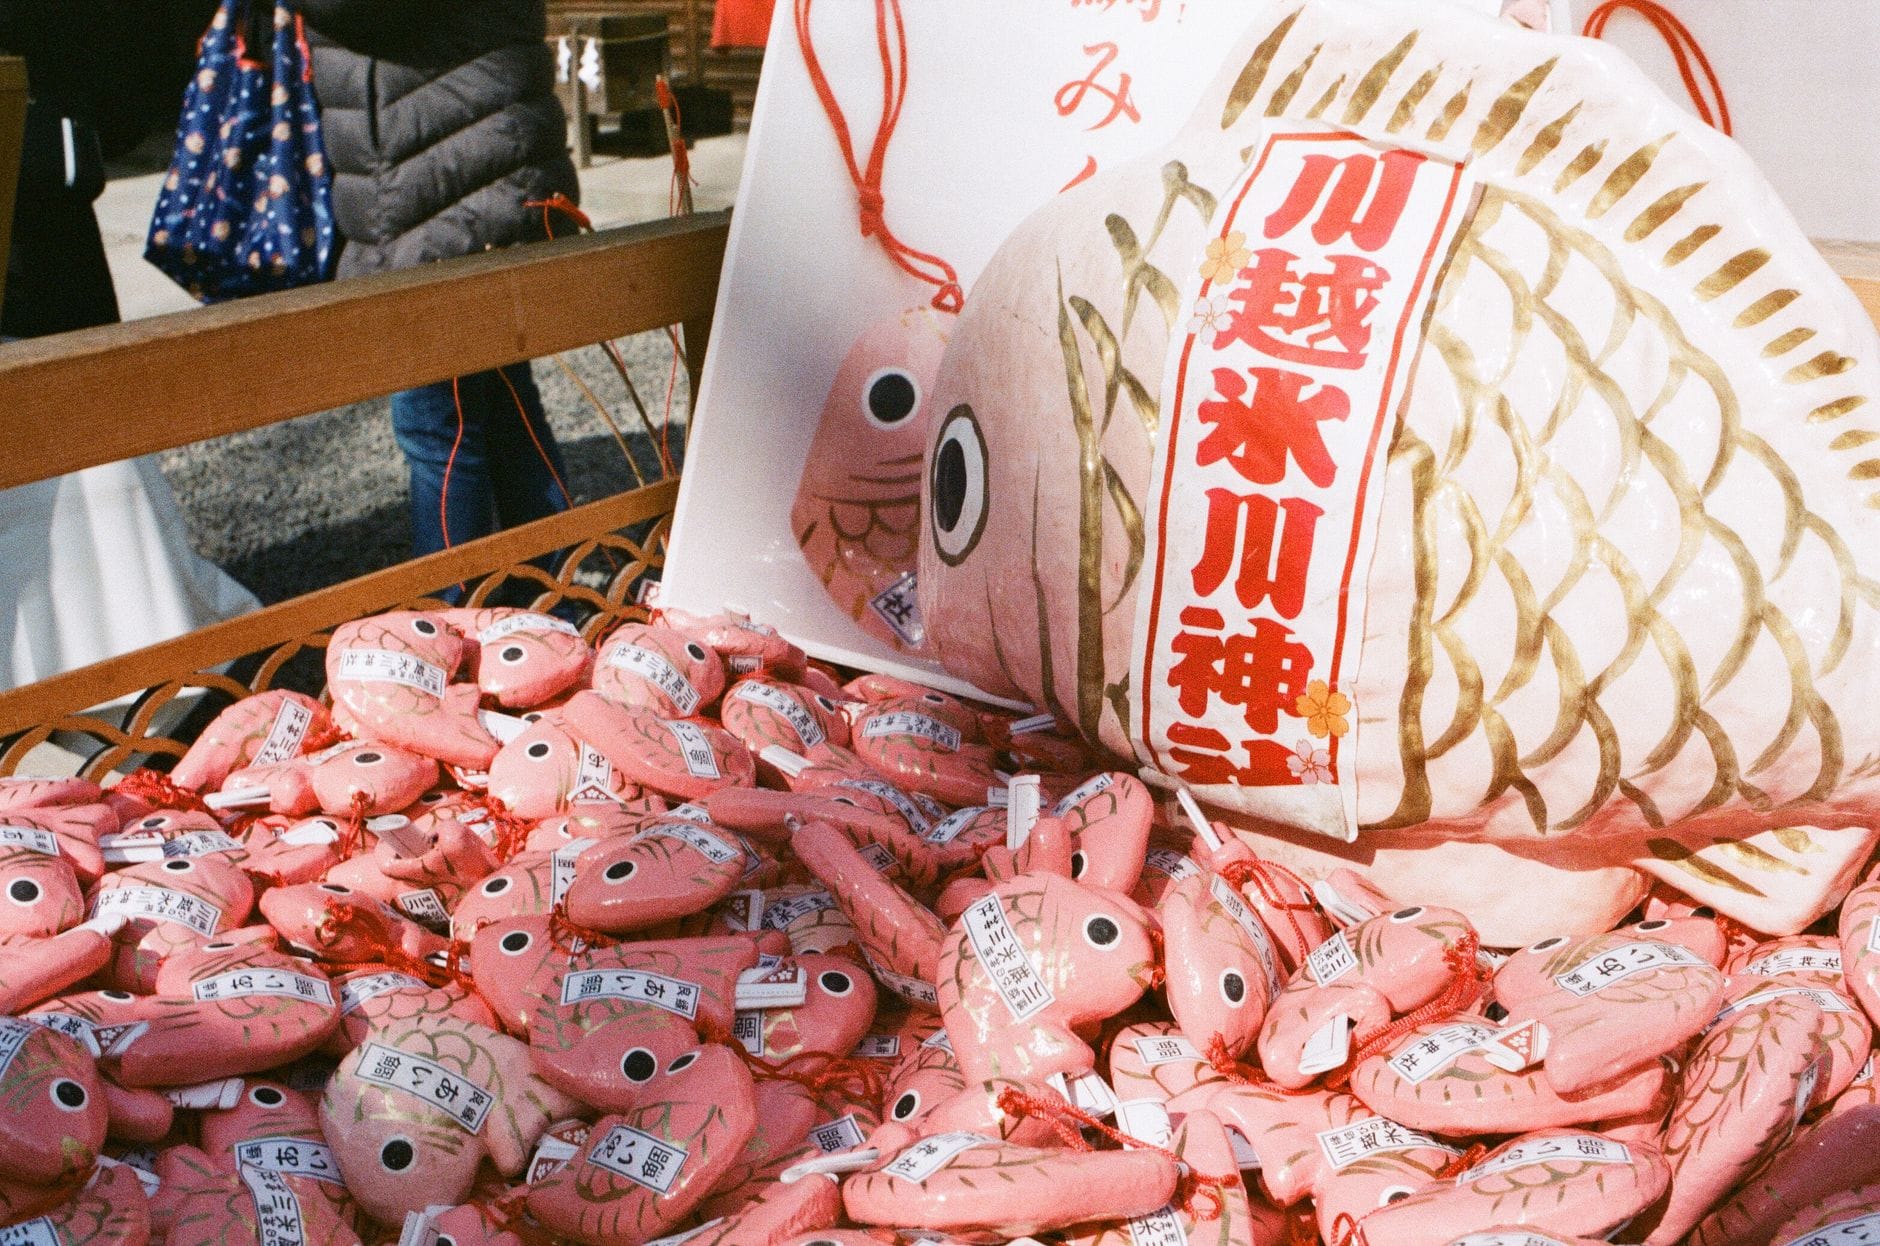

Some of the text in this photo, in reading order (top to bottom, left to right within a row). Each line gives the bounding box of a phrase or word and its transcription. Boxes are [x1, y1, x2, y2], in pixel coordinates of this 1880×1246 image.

[977, 902, 1042, 1004] 川越氷川神社
[580, 973, 666, 999] あい鯛
[372, 1051, 460, 1103] あい鯛
